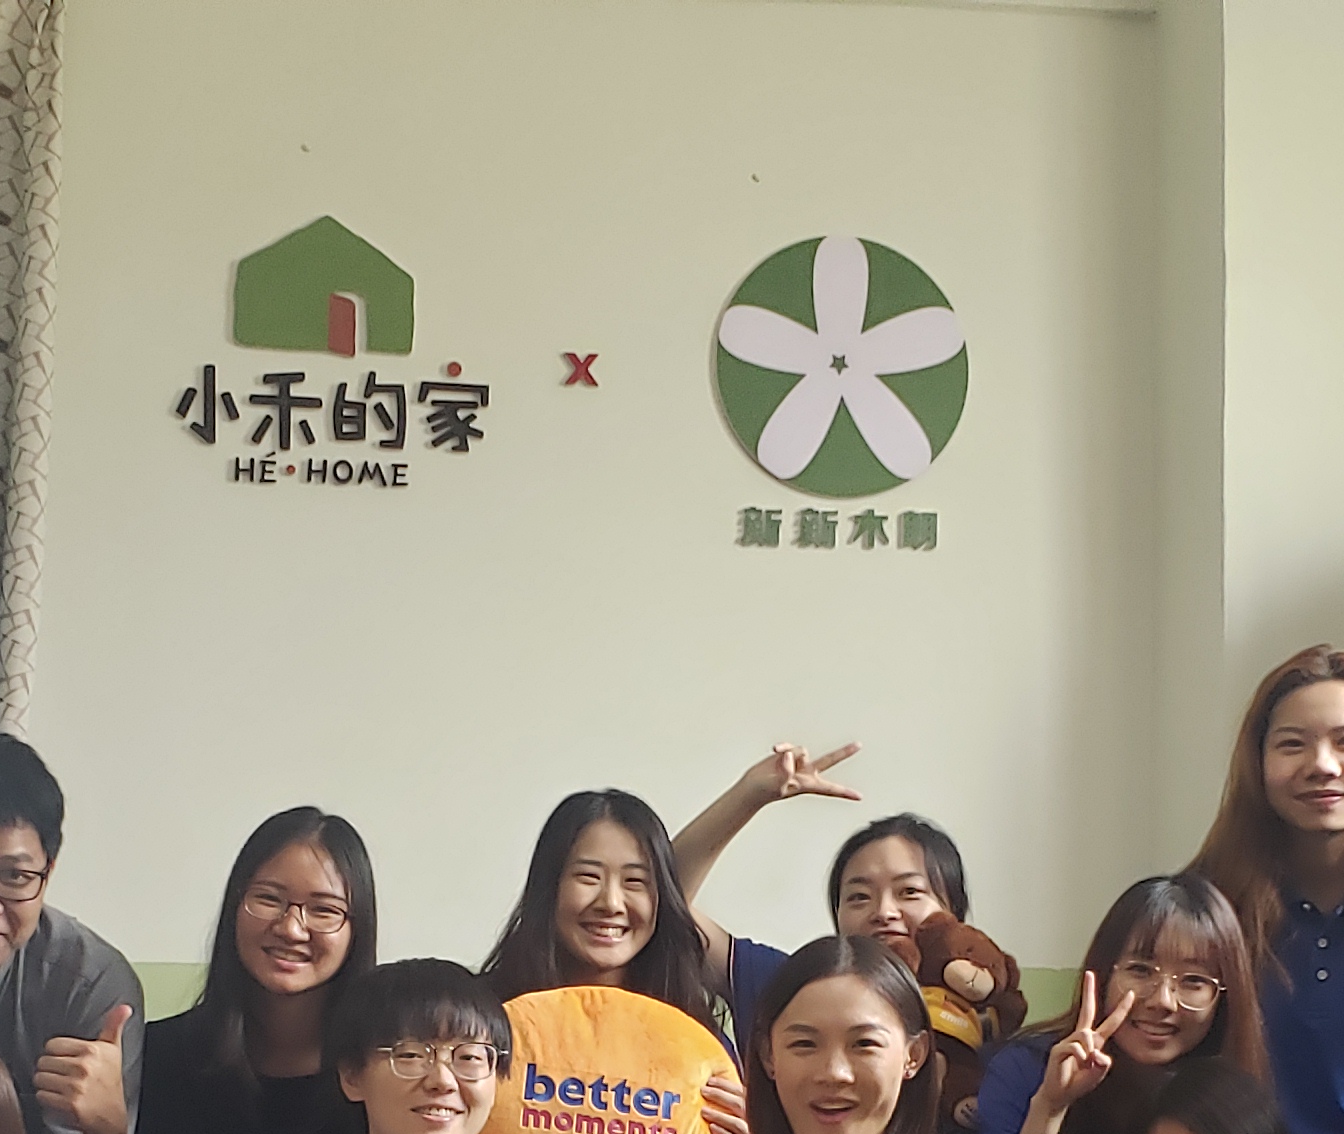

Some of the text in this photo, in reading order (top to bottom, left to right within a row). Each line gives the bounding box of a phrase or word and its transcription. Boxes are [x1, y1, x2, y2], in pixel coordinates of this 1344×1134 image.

[174, 362, 490, 452] 小禾的家
[524, 1063, 681, 1120] better
